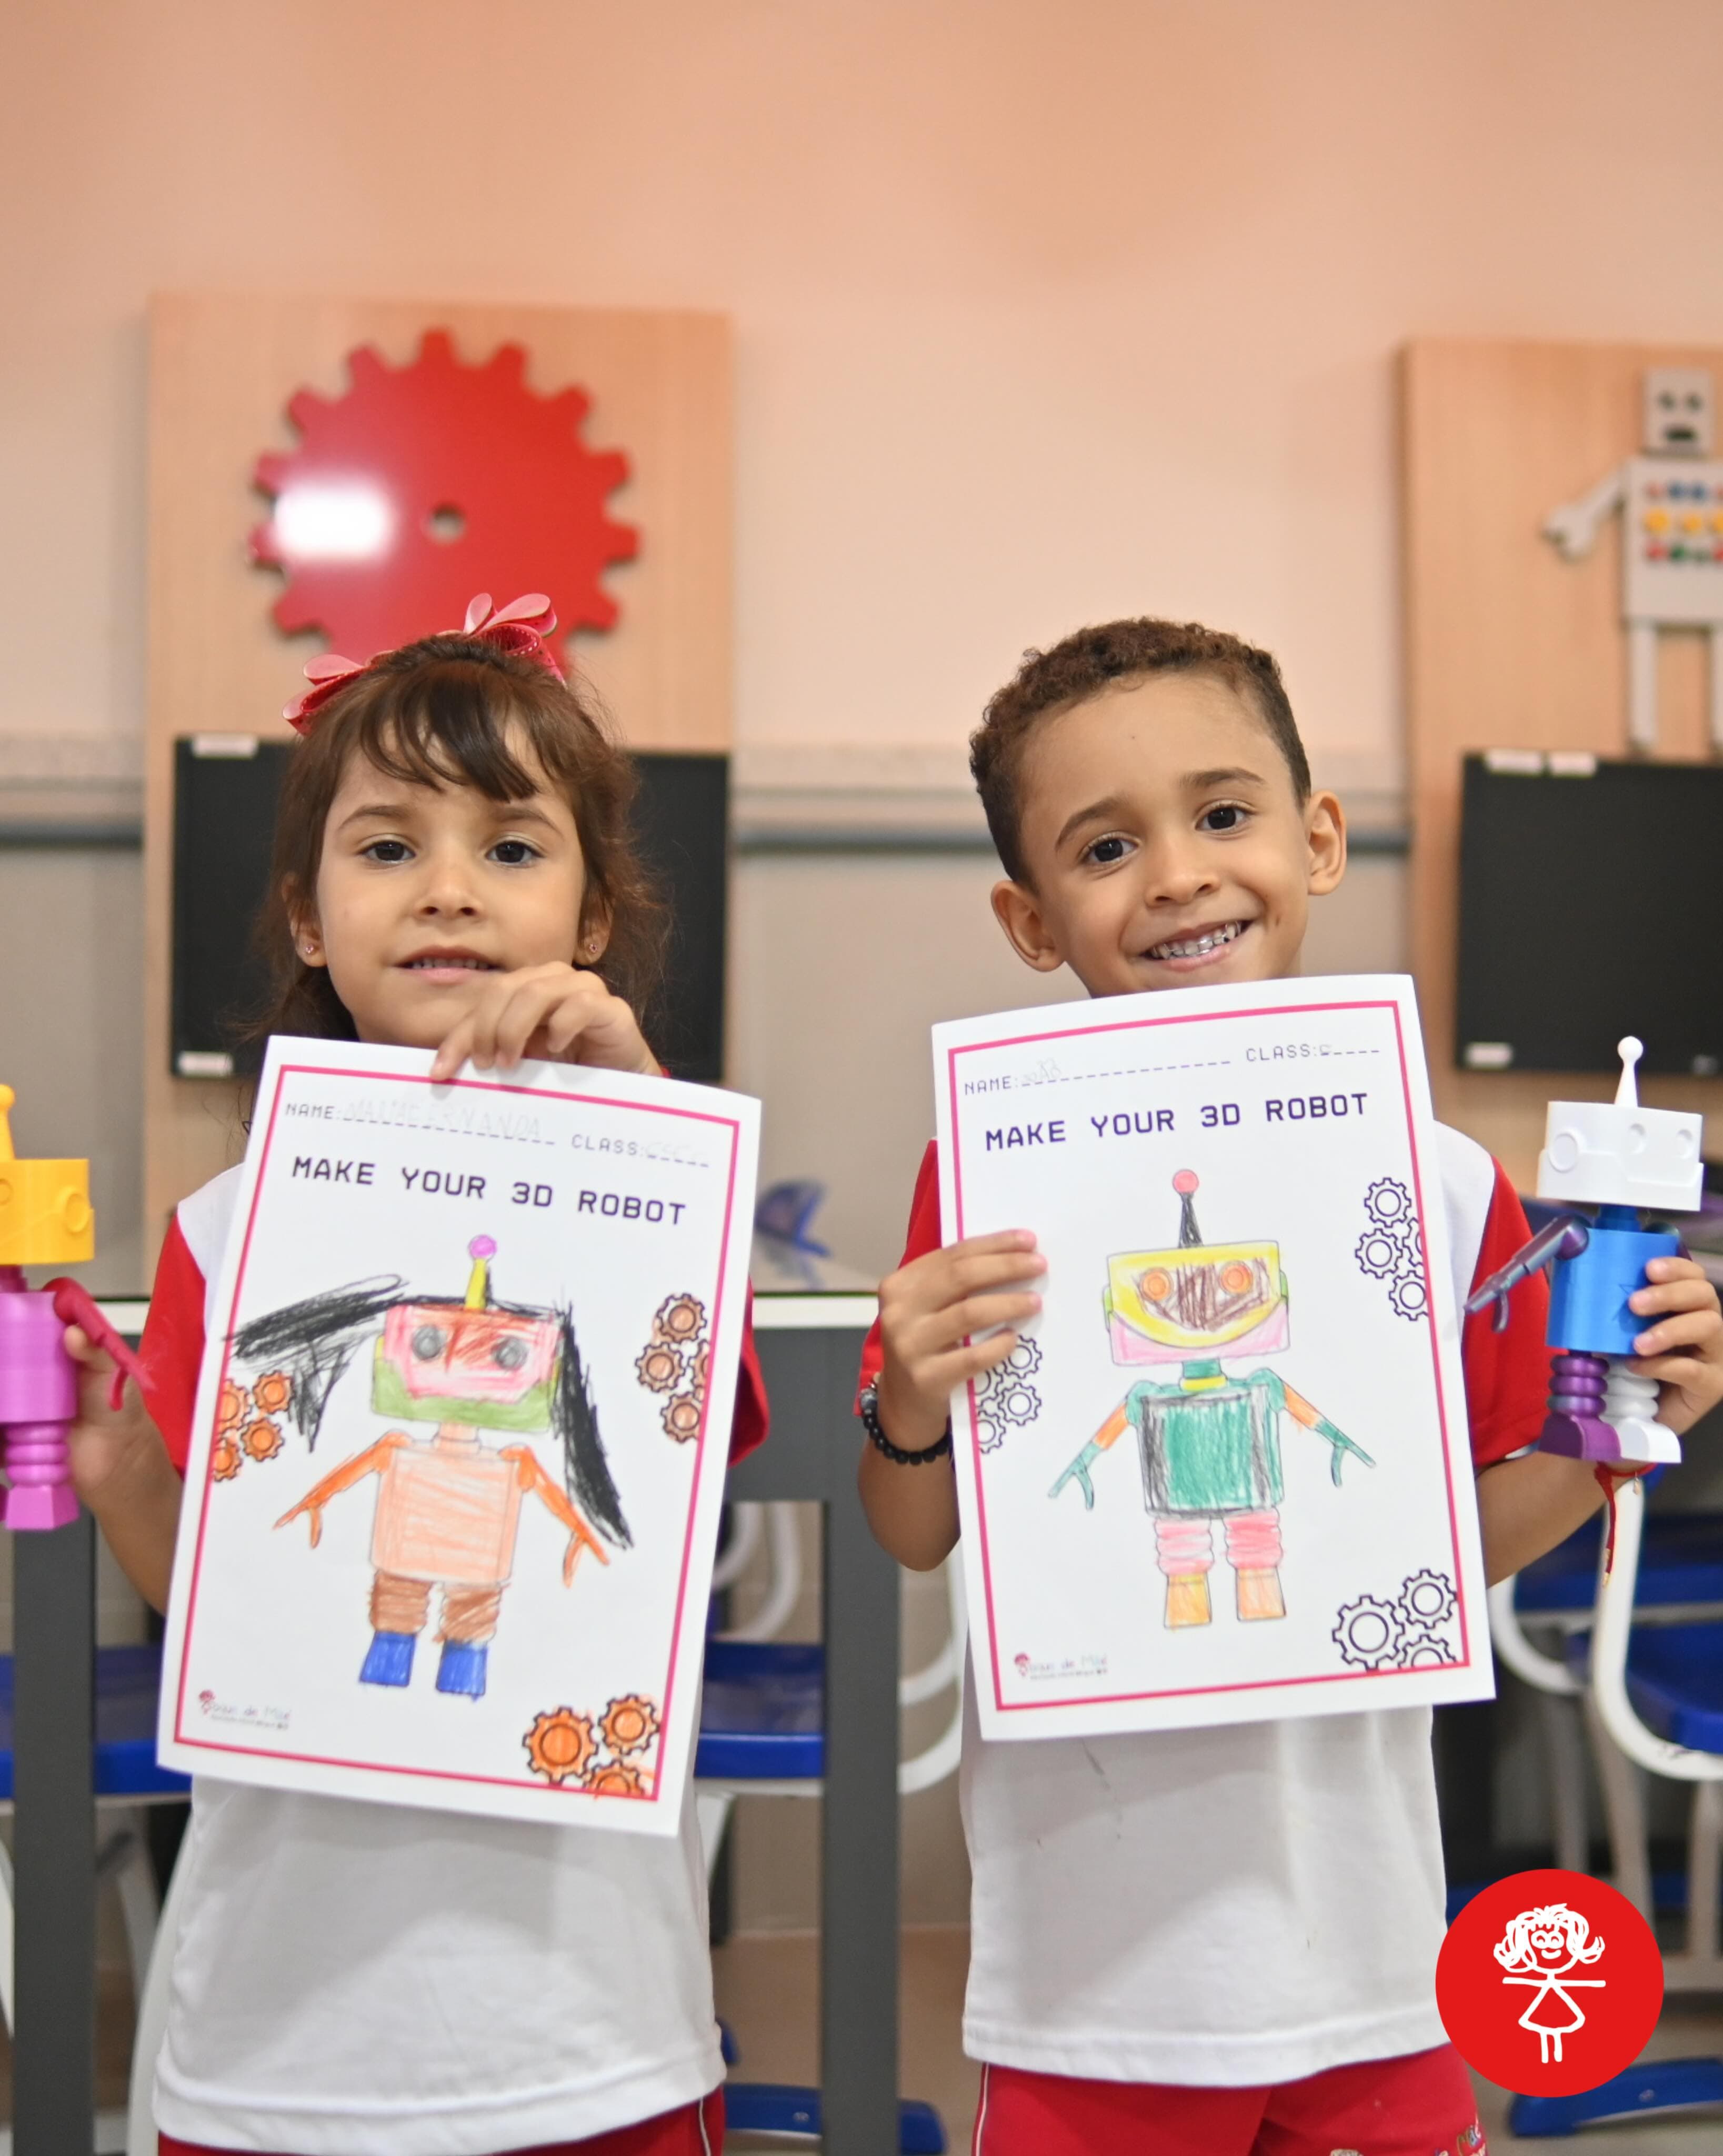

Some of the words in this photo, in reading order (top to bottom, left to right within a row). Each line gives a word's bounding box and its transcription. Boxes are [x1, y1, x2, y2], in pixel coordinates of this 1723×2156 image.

[986, 1120, 1066, 1151] MAKE
[1090, 1109, 1175, 1138] YOUR
[1200, 1103, 1240, 1127] 3D
[1265, 1093, 1367, 1122] ROBOT
[292, 1156, 375, 1185] MAKE
[402, 1167, 486, 1199] YOUR
[511, 1182, 553, 1207] 3D
[577, 1190, 686, 1225] ROBOT
